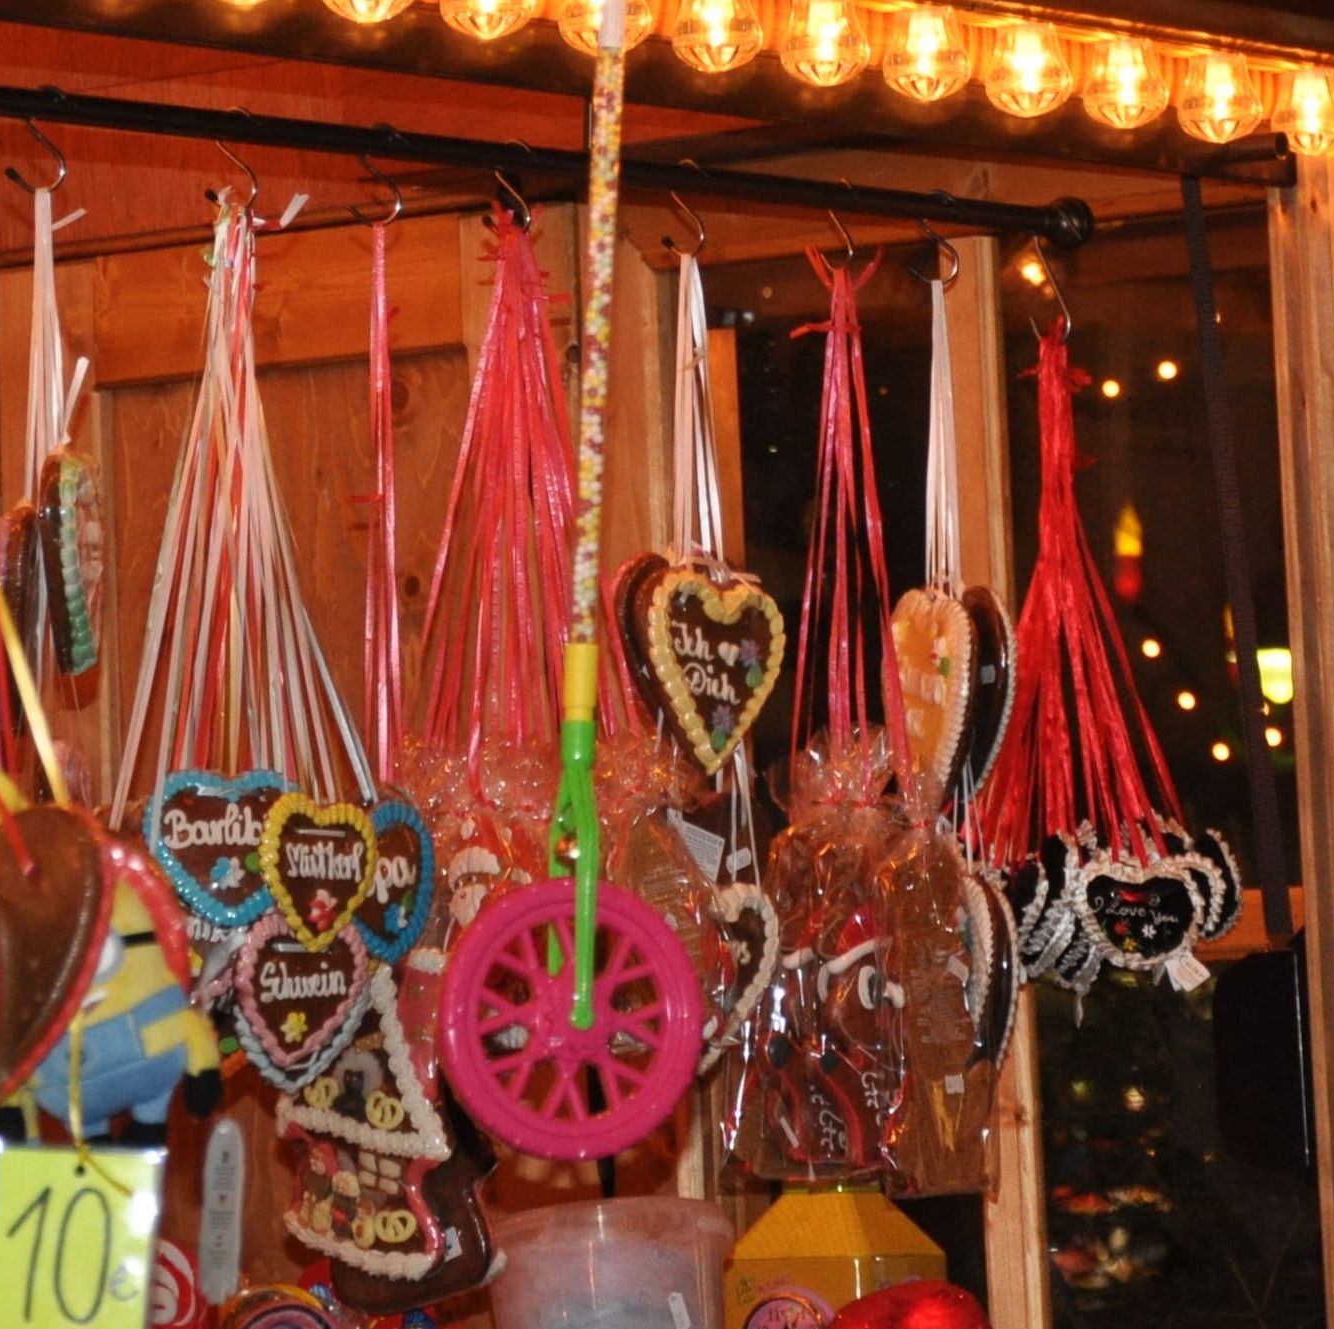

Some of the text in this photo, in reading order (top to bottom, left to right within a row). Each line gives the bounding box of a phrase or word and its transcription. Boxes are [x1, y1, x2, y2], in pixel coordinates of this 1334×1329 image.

[671, 619, 715, 661] Ich
[683, 662, 741, 705] Dich
[367, 856, 416, 904] pa
[6, 1186, 112, 1325] 10
